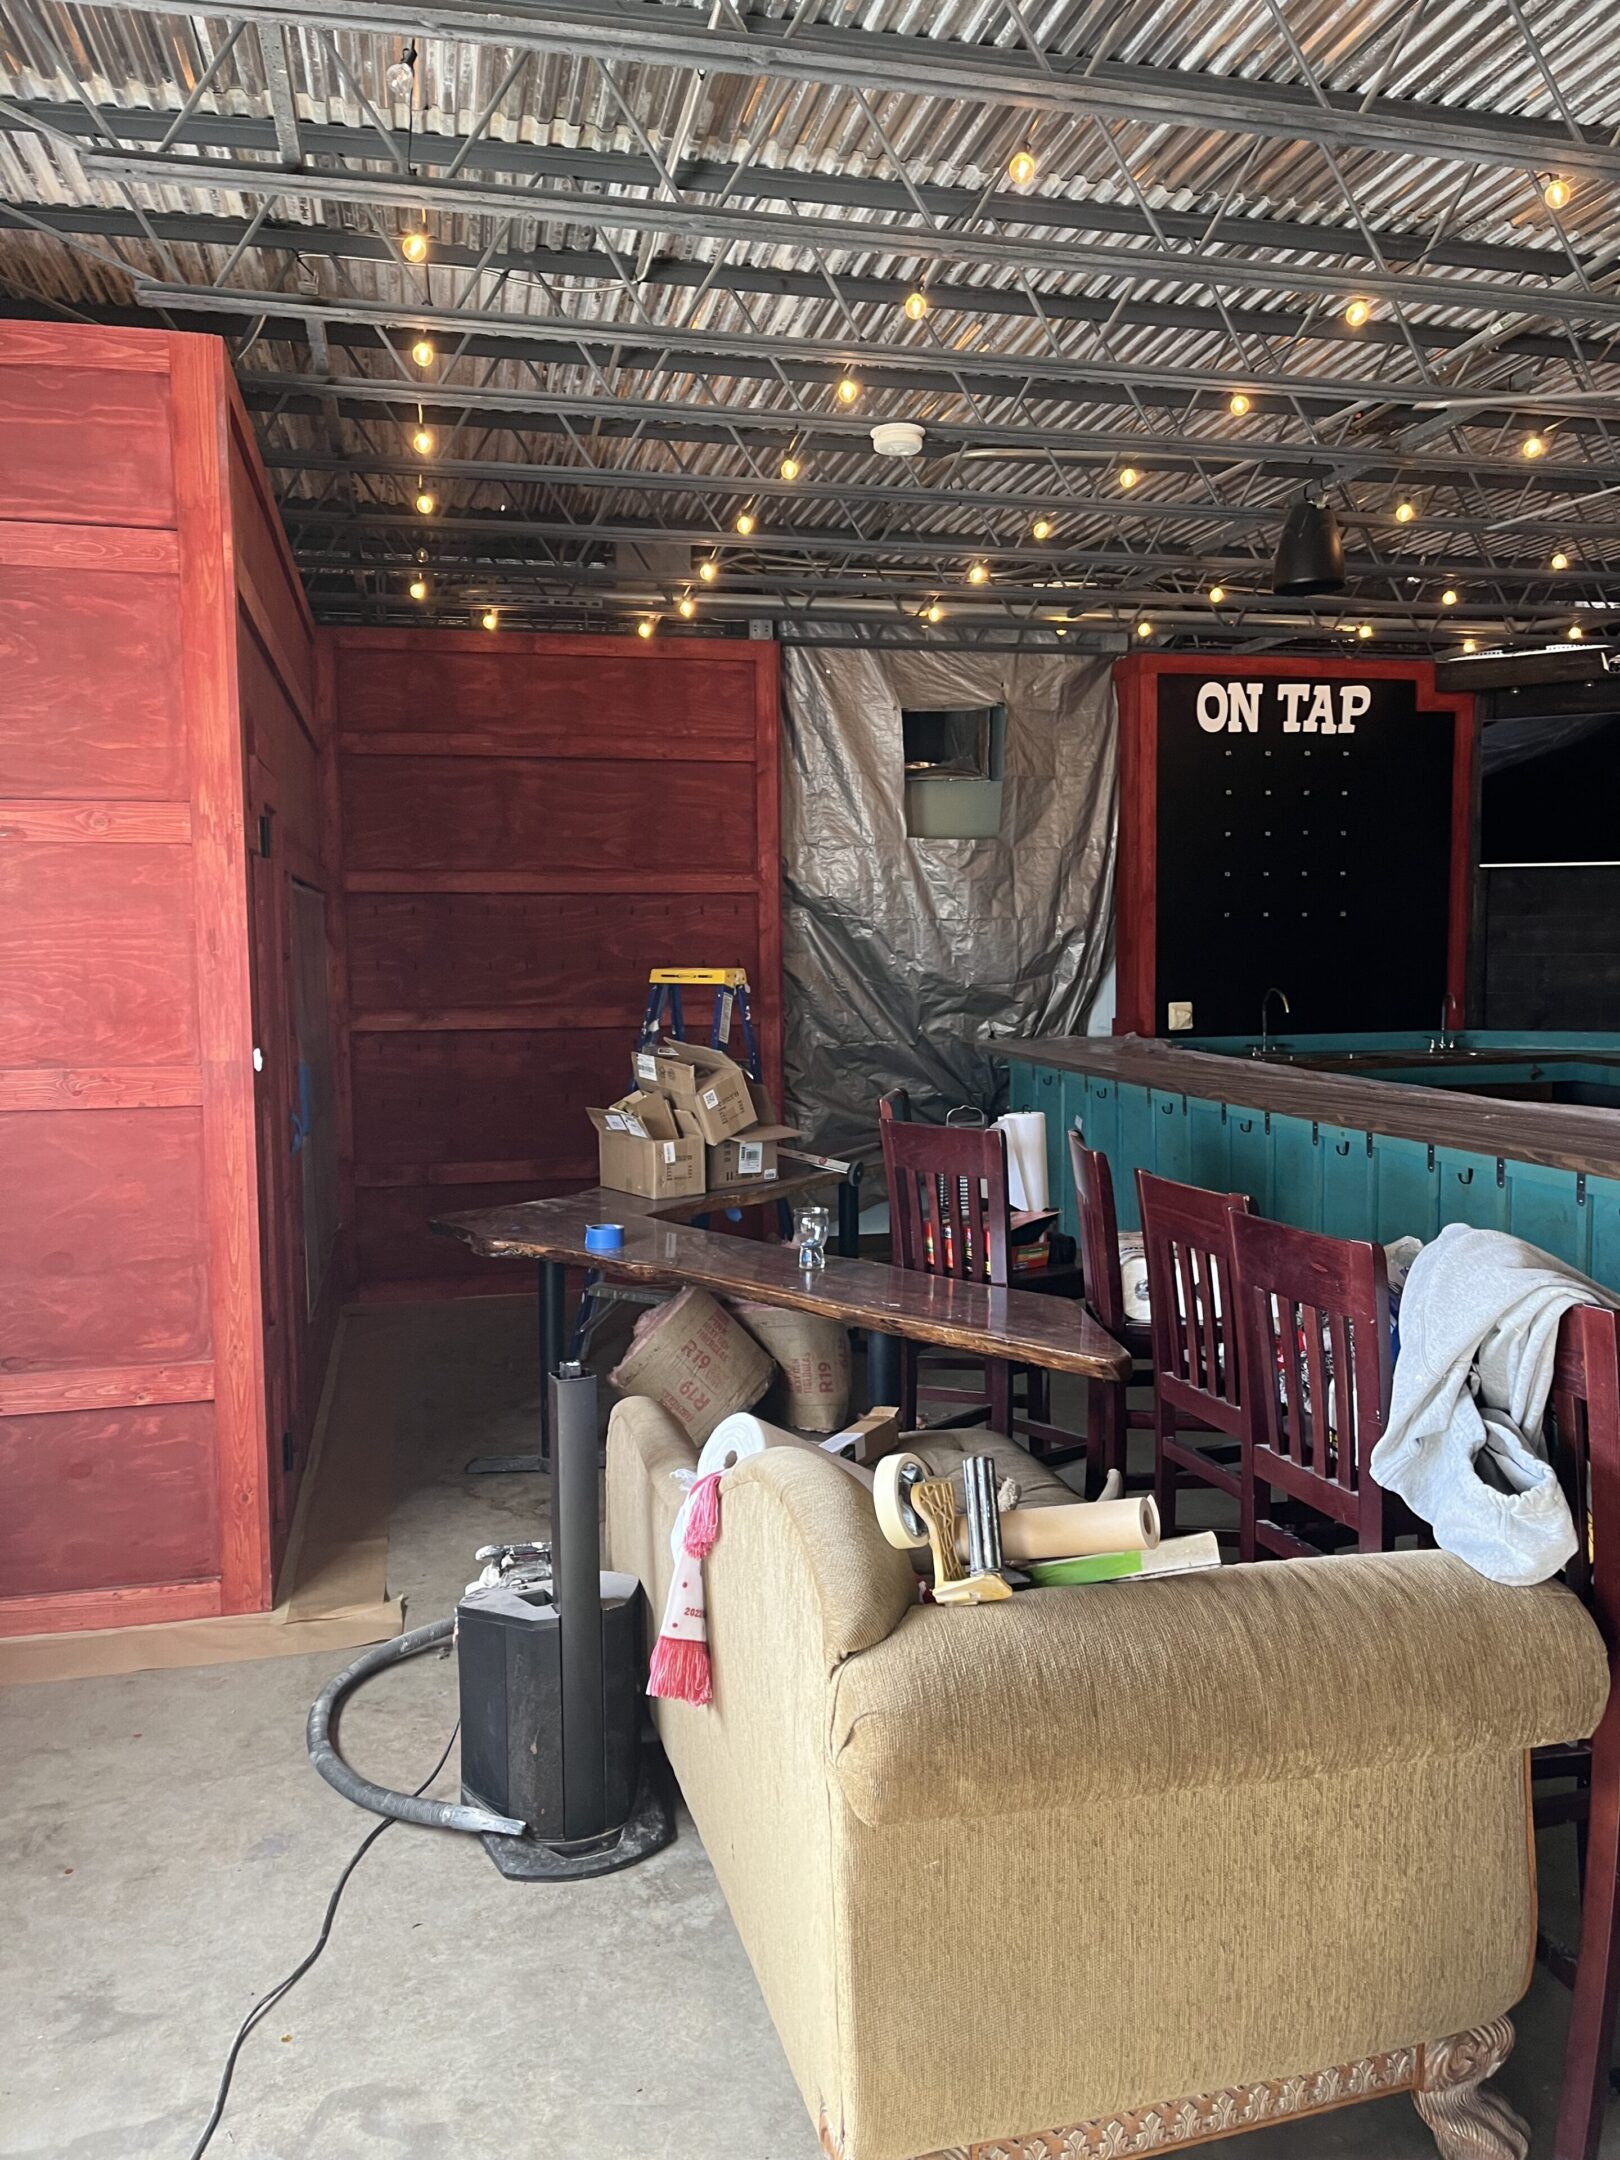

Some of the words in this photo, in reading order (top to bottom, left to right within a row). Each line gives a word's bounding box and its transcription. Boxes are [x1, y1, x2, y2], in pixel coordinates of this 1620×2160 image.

[1196, 681, 1264, 733] ON
[1277, 684, 1371, 734] TAP
[681, 1339, 711, 1369] R19
[818, 1362, 833, 1393] R19
[680, 1381, 711, 1411] R19
